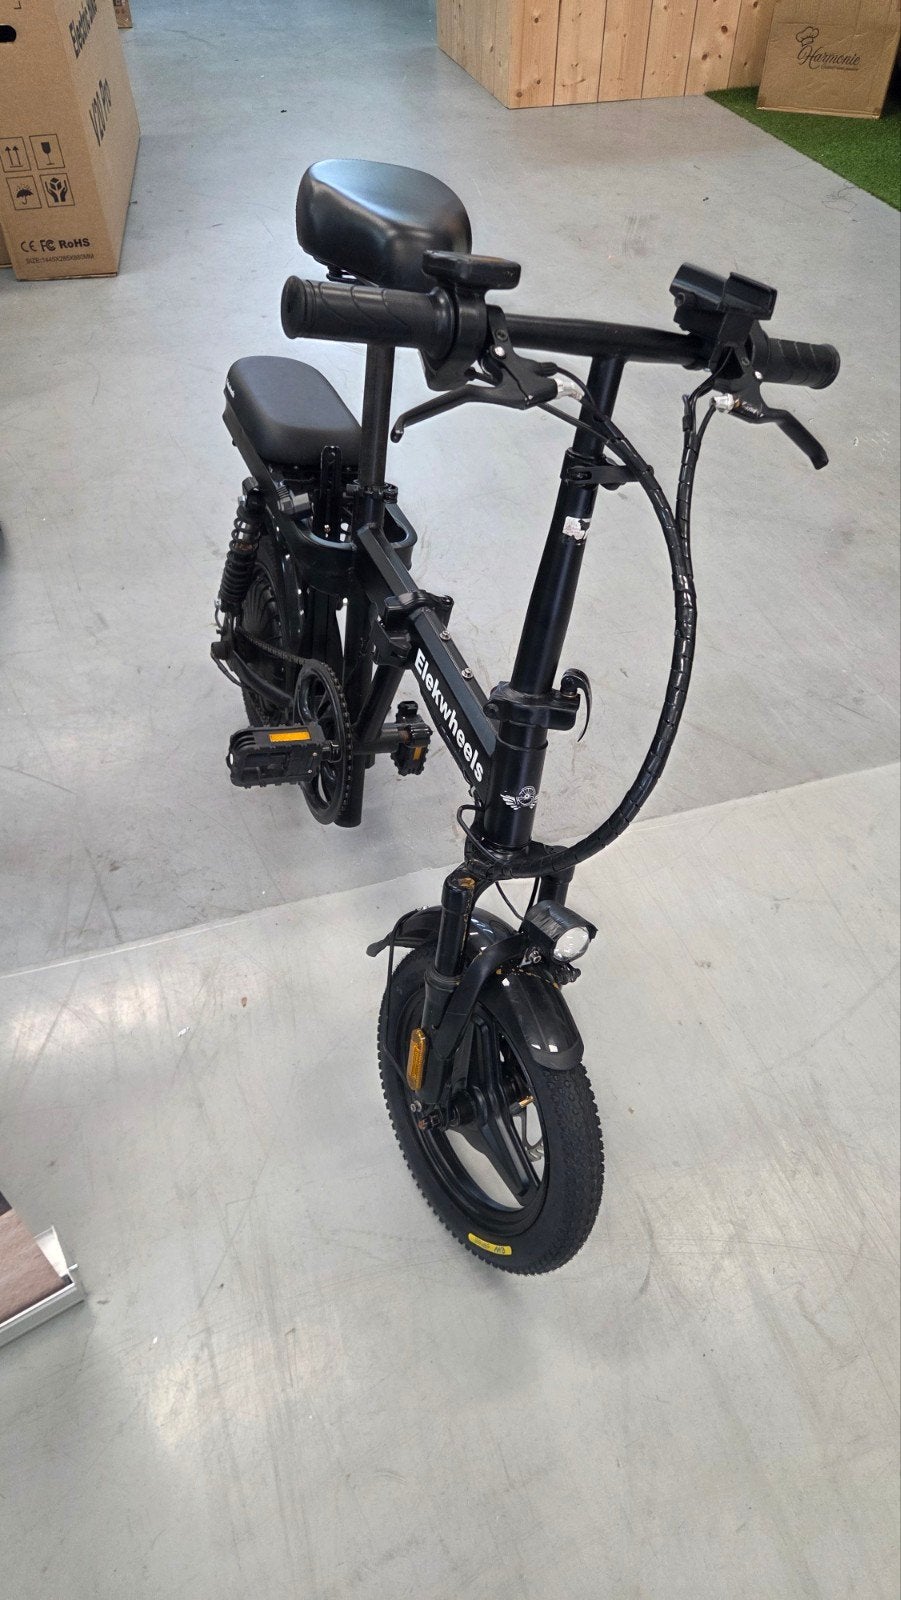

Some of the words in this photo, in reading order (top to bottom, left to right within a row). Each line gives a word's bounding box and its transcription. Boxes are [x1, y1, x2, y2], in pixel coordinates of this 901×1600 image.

[798, 45, 861, 69] Harmonie
[99, 78, 111, 121] Pro
[59, 238, 90, 249] RoHS
[414, 648, 484, 782] Elekwheels
